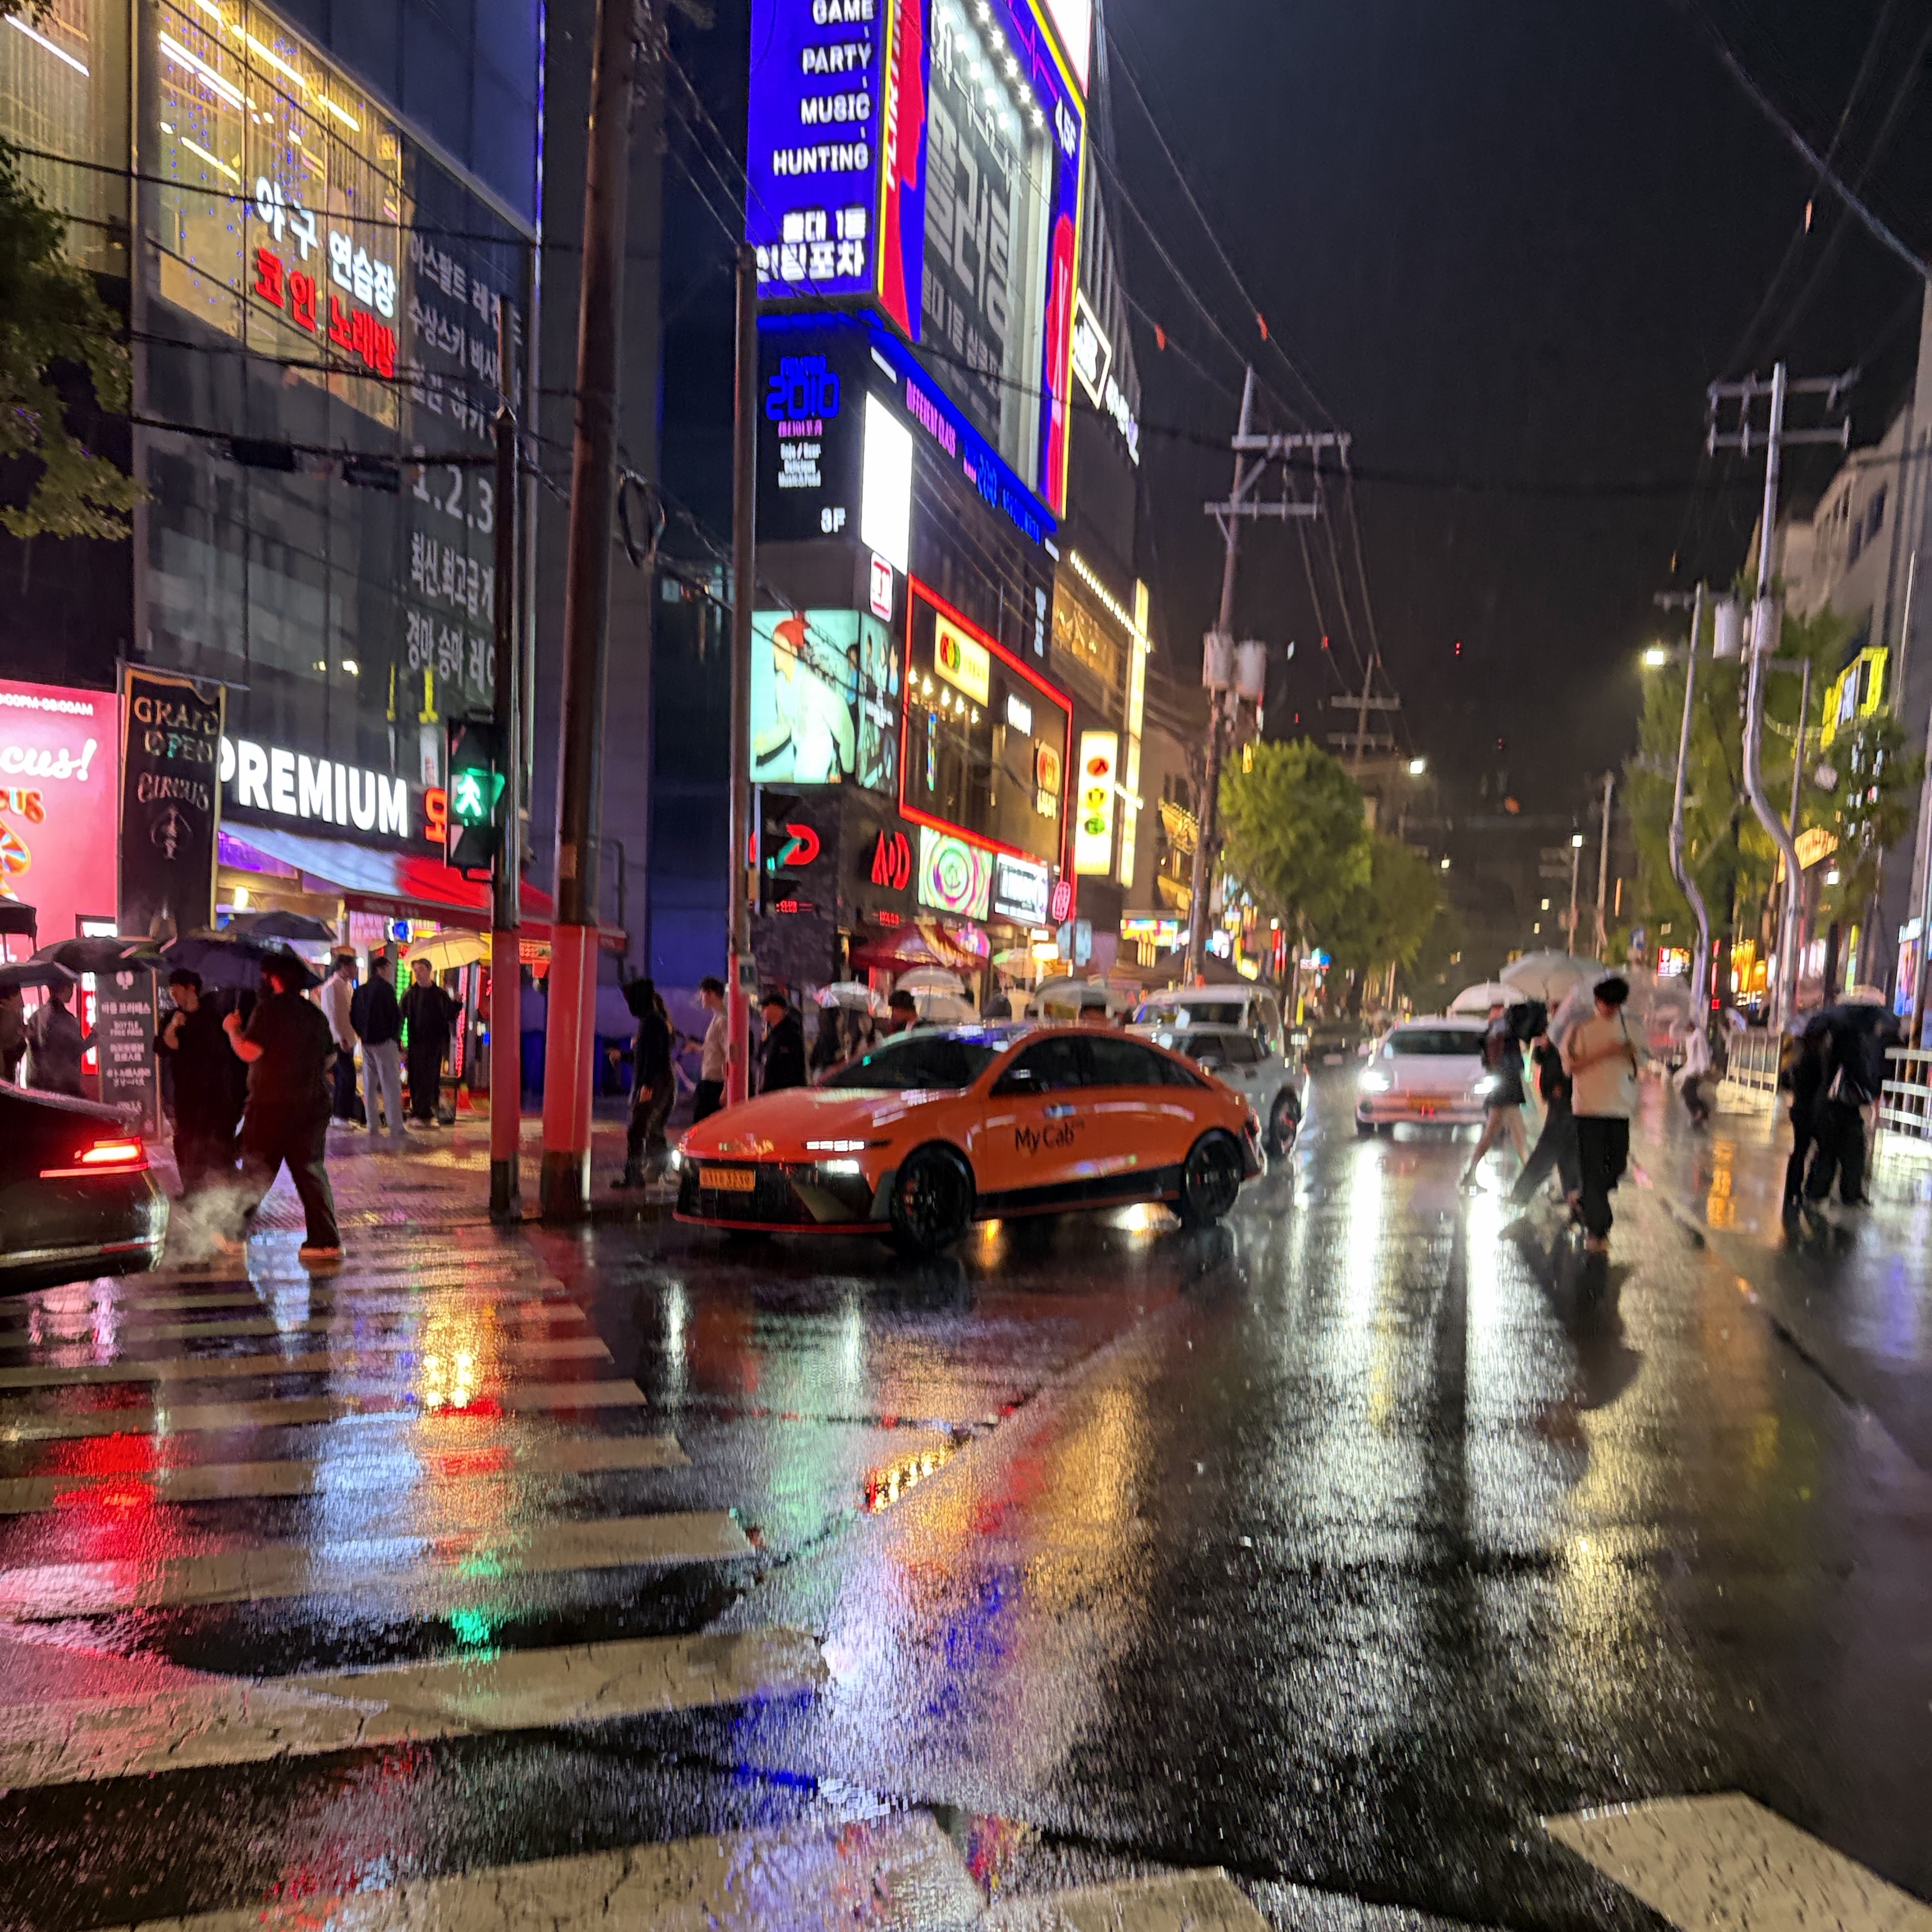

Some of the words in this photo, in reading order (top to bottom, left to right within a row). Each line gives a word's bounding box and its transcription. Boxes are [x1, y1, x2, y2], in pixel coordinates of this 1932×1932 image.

[813, 0, 874, 25] GAME
[803, 42, 871, 75] PARTY
[800, 92, 870, 125] MUSIC
[773, 143, 868, 176] HUNTING
[256, 176, 318, 261] 야구
[330, 230, 396, 318] 연습장
[254, 246, 316, 333] 코인
[329, 294, 396, 379] 노래방
